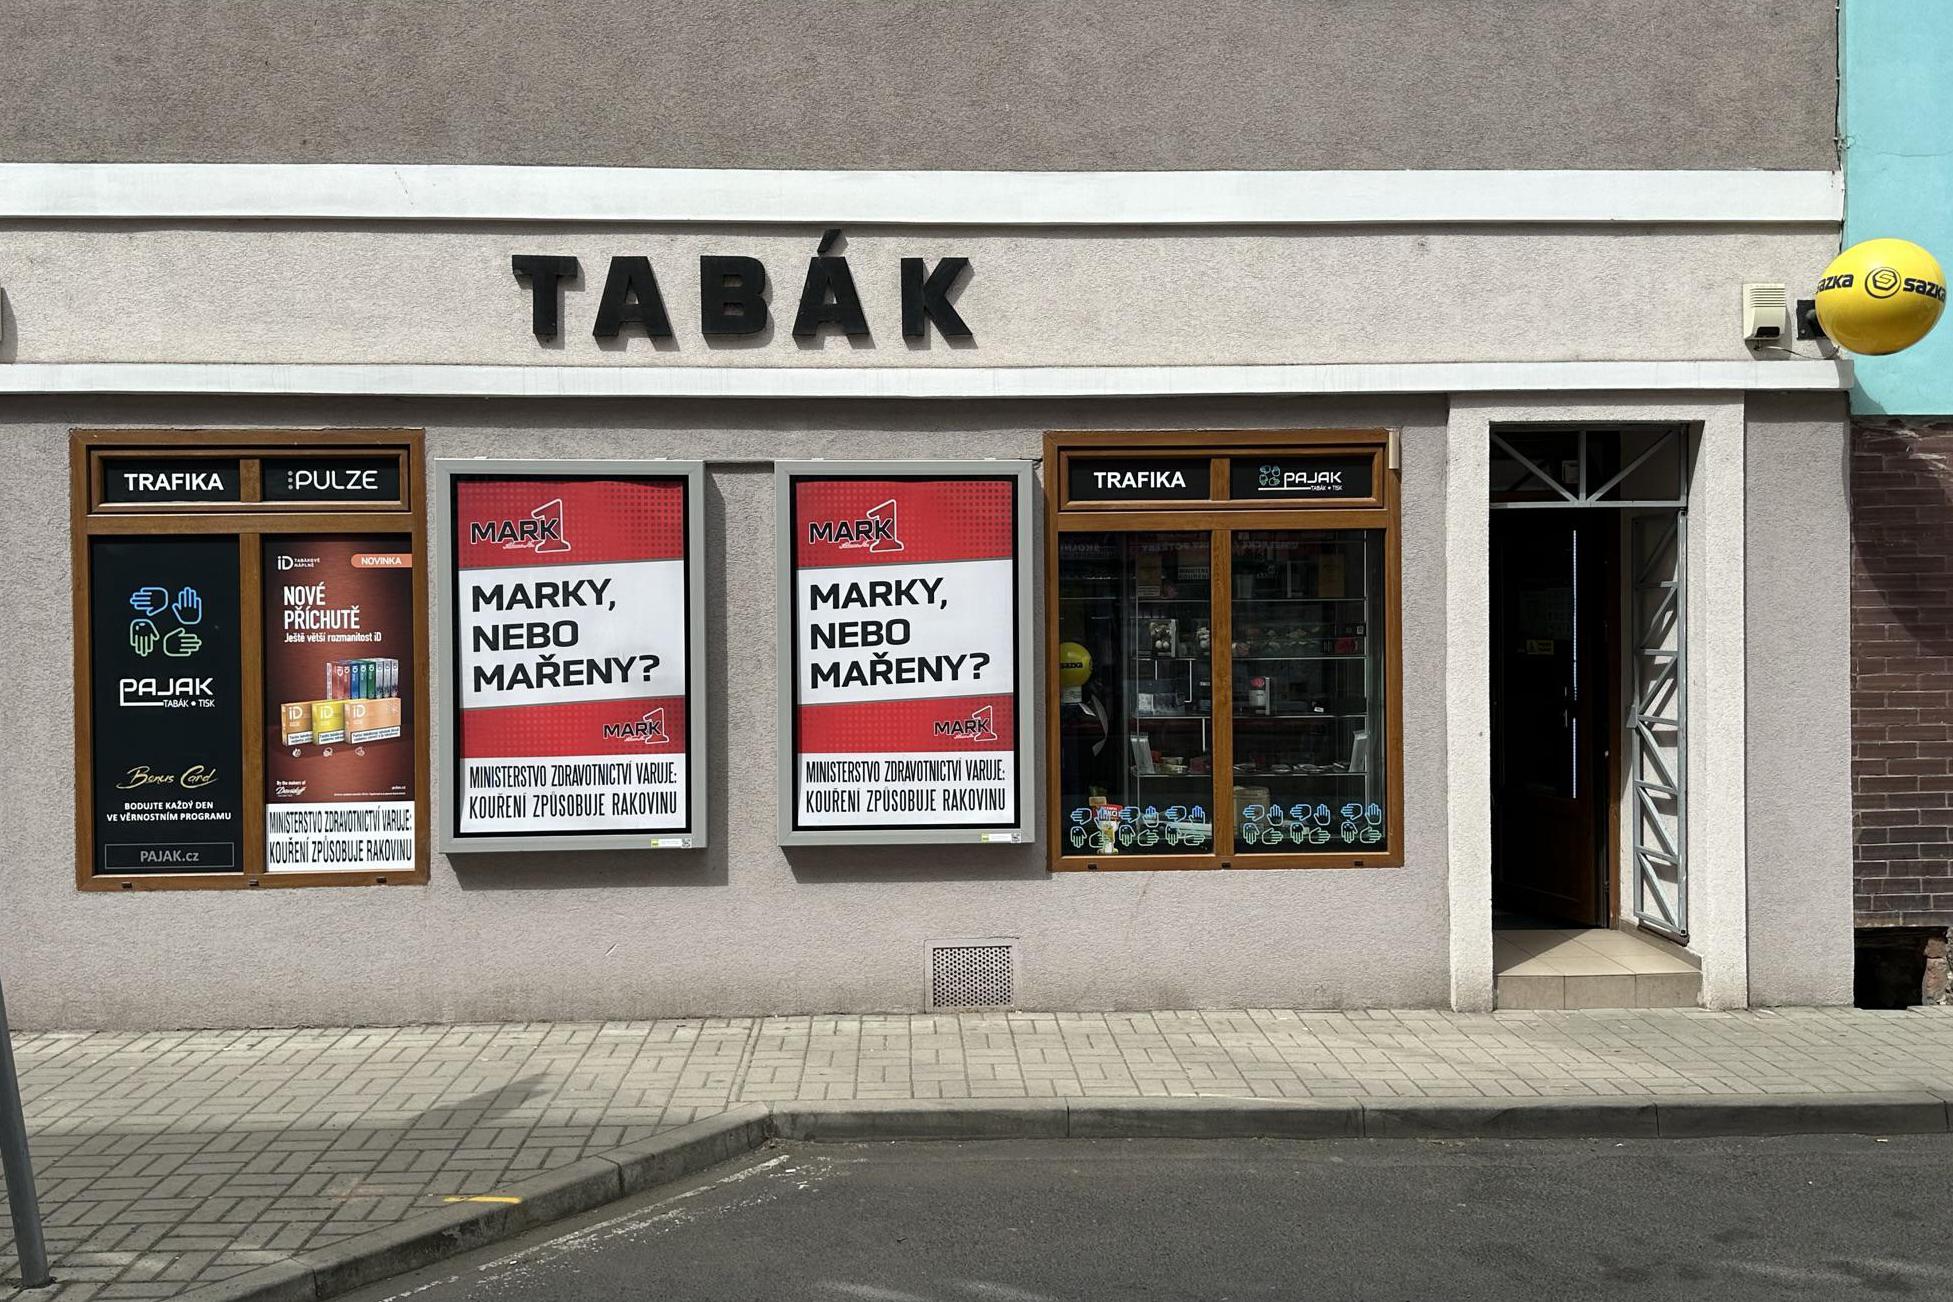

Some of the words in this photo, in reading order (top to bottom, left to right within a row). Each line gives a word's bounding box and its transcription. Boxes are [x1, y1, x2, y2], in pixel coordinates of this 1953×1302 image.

[512, 228, 973, 337] TABÁK
[124, 472, 224, 491] TRAFIKA
[295, 470, 379, 490] PULZE
[1094, 471, 1186, 488] TRAFIKA
[1284, 471, 1342, 485] PAJAK
[361, 557, 402, 565] NOVINKA
[283, 581, 326, 606] NOVÉ
[472, 578, 616, 612] MARKY,
[810, 577, 948, 610] MARKY,
[284, 605, 360, 630] PŘÍCHUTĚ
[284, 632, 305, 643] Ještě
[307, 632, 326, 643] větší
[327, 632, 373, 642] rozmanitost
[472, 620, 579, 652] NEBO
[810, 618, 910, 650] NEBO
[473, 653, 660, 692] MAŘENY?
[811, 651, 990, 689] MAŘENY?
[119, 677, 214, 698] PAJAK
[163, 698, 189, 708] TABÁK
[199, 699, 215, 708] TISK
[116, 765, 175, 789] Bonus
[180, 765, 218, 789] Card
[469, 765, 546, 788] MINISTERSTVO
[551, 761, 632, 787] ZDRAVOTNICTVÍ
[636, 762, 677, 784] VARUJE:
[806, 760, 880, 783] MINISTERSTVO
[884, 757, 962, 782] ZDRAVOTNICTVÍ
[965, 759, 1005, 780] VARUJE:
[124, 802, 163, 810] BODUJTE
[165, 800, 193, 810] KAŽDÝ
[195, 801, 214, 809] DEN
[469, 792, 526, 819] KOUŘENÍ
[533, 791, 605, 817] ZPŮSOBUJE
[612, 791, 677, 815] RAKOVINU
[806, 787, 860, 813] KOUŘENÍ
[866, 786, 936, 812] ZPŮSOBUJE
[943, 788, 1005, 811] RAKOVINU
[107, 813, 118, 821] VE
[120, 811, 178, 822] VĚRNOSTNÍM
[180, 812, 231, 821] PROGRAMU
[269, 811, 323, 833] MINISTERSTVO
[324, 805, 381, 832] ZDRAVOTNICTVÍ
[381, 808, 412, 831] VARUJE:
[140, 850, 199, 862] PAJAK.cz
[269, 837, 309, 863] KOUŘENÍ
[311, 835, 364, 862] ZPŮSOBUJE
[366, 839, 412, 861] RAKOVINU
